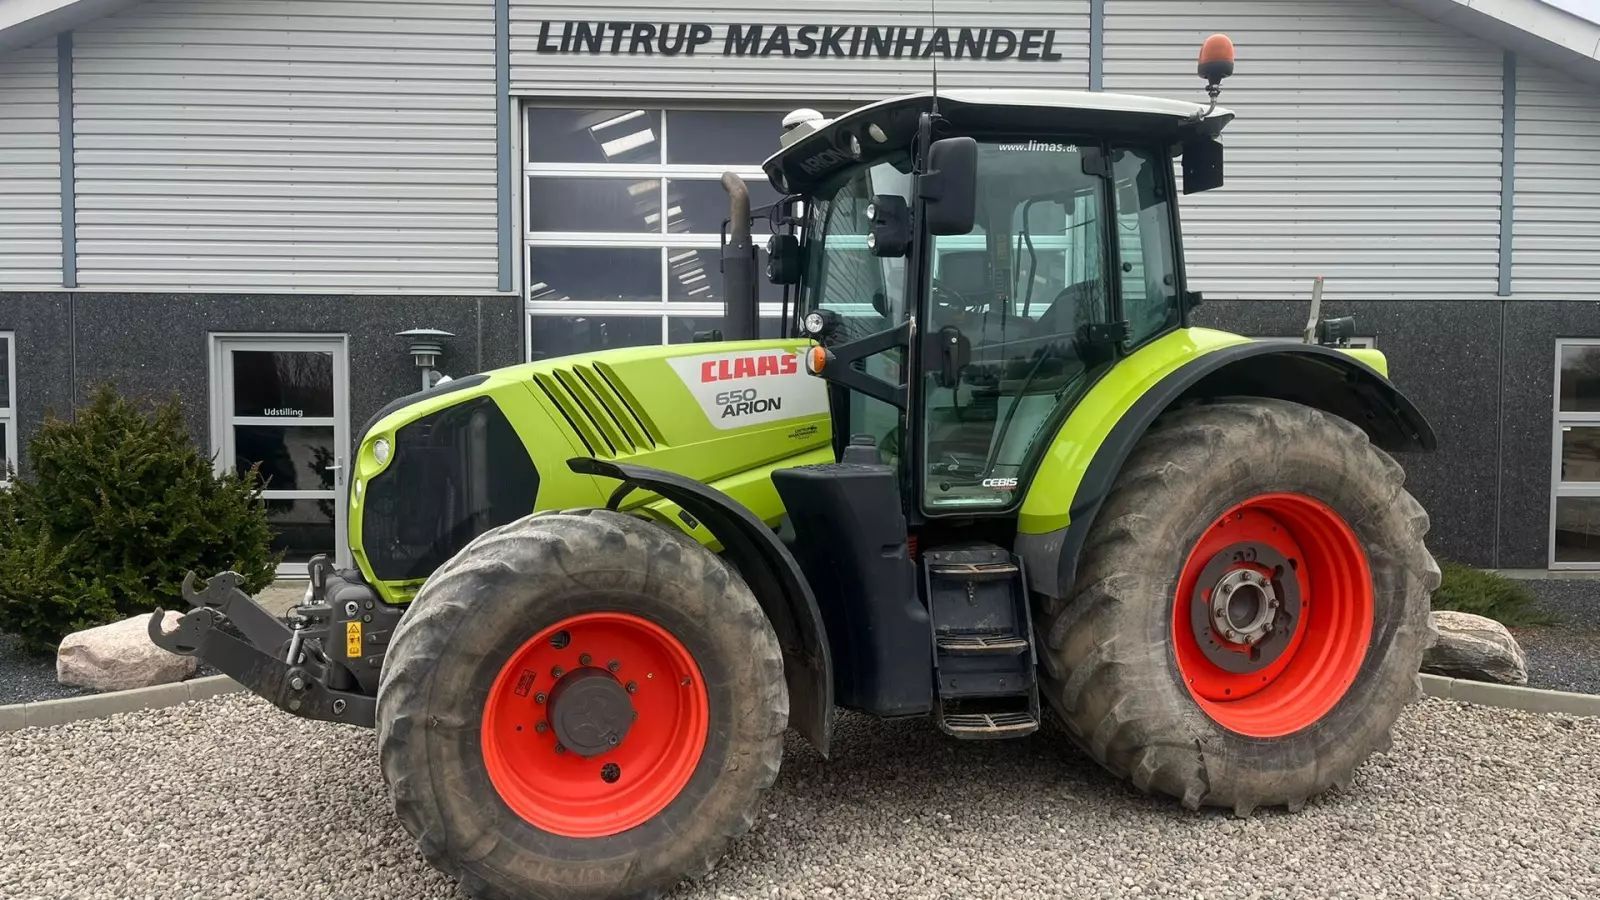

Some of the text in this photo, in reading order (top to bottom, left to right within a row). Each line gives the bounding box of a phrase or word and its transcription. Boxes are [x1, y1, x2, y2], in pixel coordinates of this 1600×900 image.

[536, 21, 1063, 61] LINTRUP MASKINHANDEL
[998, 140, 1079, 152] www.limas.dk
[701, 354, 797, 383] CLAAS
[716, 388, 757, 405] 650
[264, 408, 303, 417] Udstilling
[721, 397, 781, 418] ARION
[982, 478, 1018, 487] CEBIS
